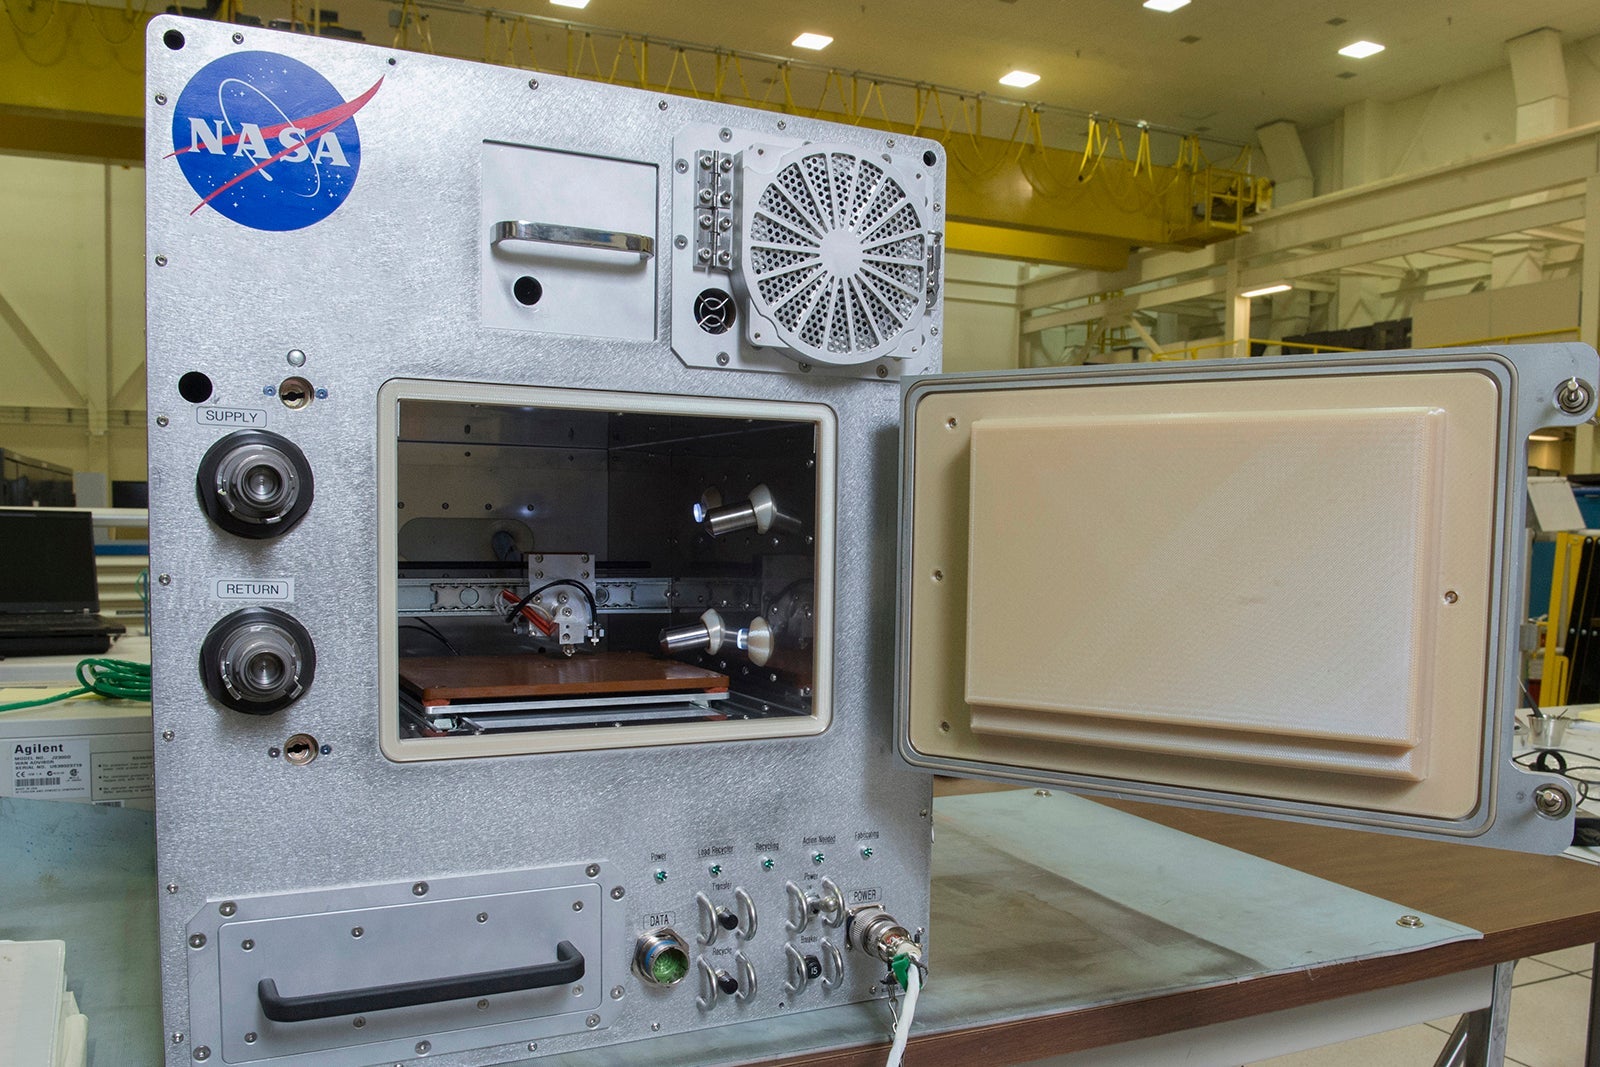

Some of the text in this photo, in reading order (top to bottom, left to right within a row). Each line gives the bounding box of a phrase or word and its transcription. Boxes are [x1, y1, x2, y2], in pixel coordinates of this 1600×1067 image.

[187, 117, 351, 167] NASA
[206, 409, 258, 423] SUPPLY
[226, 583, 279, 595] RETURN
[14, 744, 64, 756] Agilent
[650, 852, 667, 861] Power
[803, 872, 819, 880] Power
[853, 889, 877, 902] POWER
[649, 914, 670, 927] DATA
